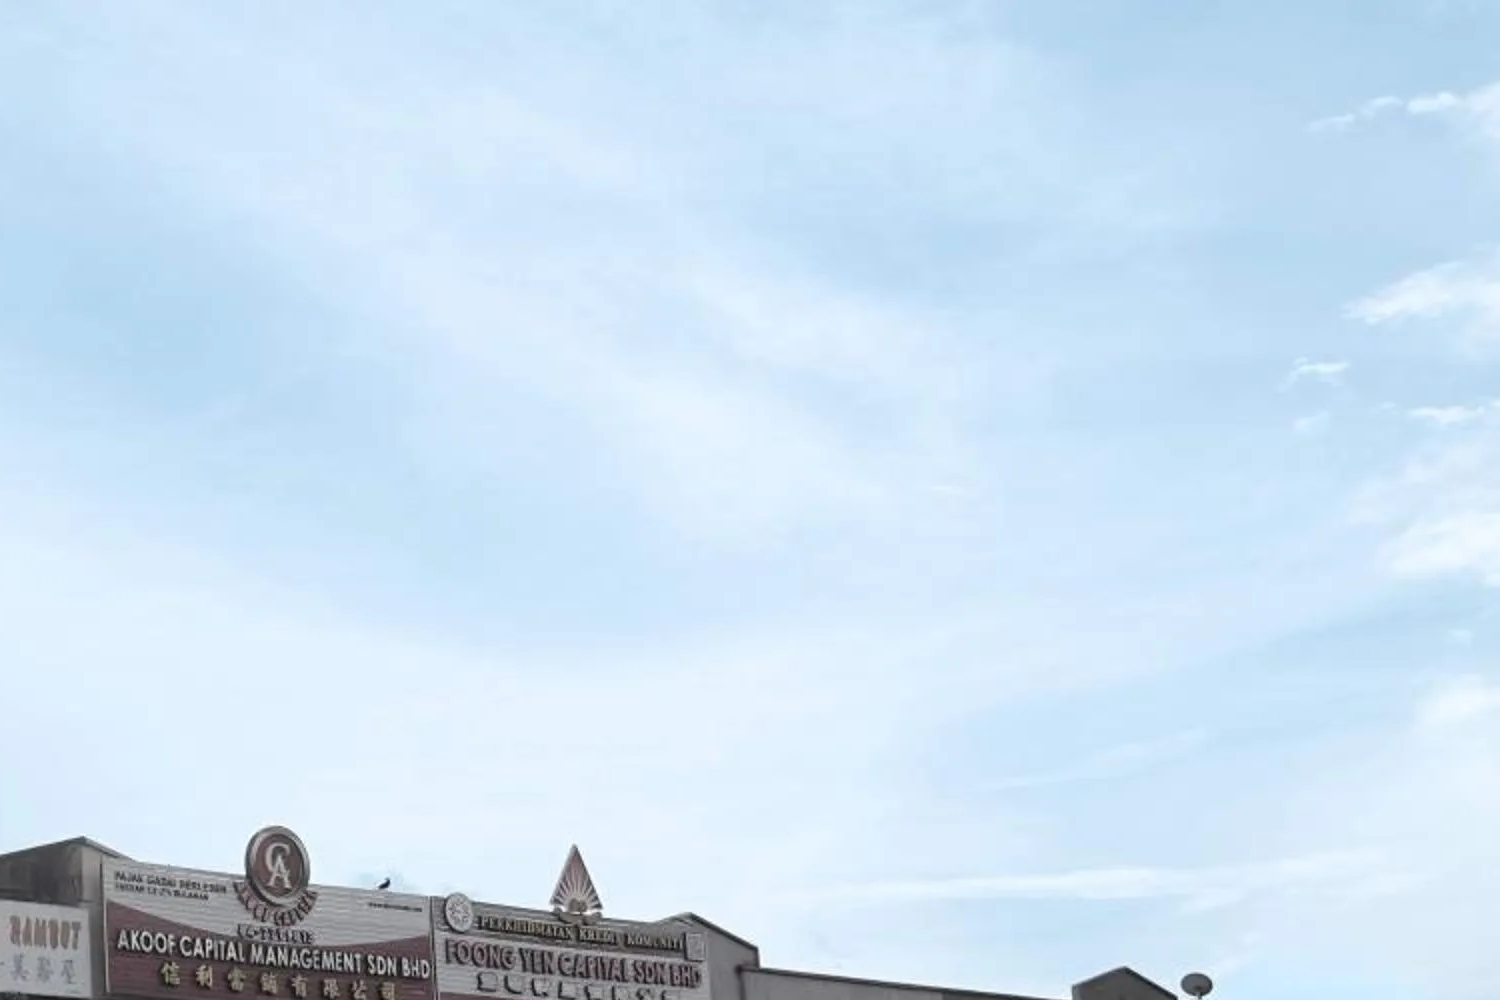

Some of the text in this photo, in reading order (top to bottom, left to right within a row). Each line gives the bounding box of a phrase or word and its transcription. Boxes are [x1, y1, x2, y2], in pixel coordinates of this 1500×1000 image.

[9, 914, 82, 950] RAMBUT
[117, 929, 431, 979] AKOOF CAPITAL MANAGEMENT SDN BHD
[557, 952, 629, 983] CAPITAL
[633, 960, 667, 985] SDN
